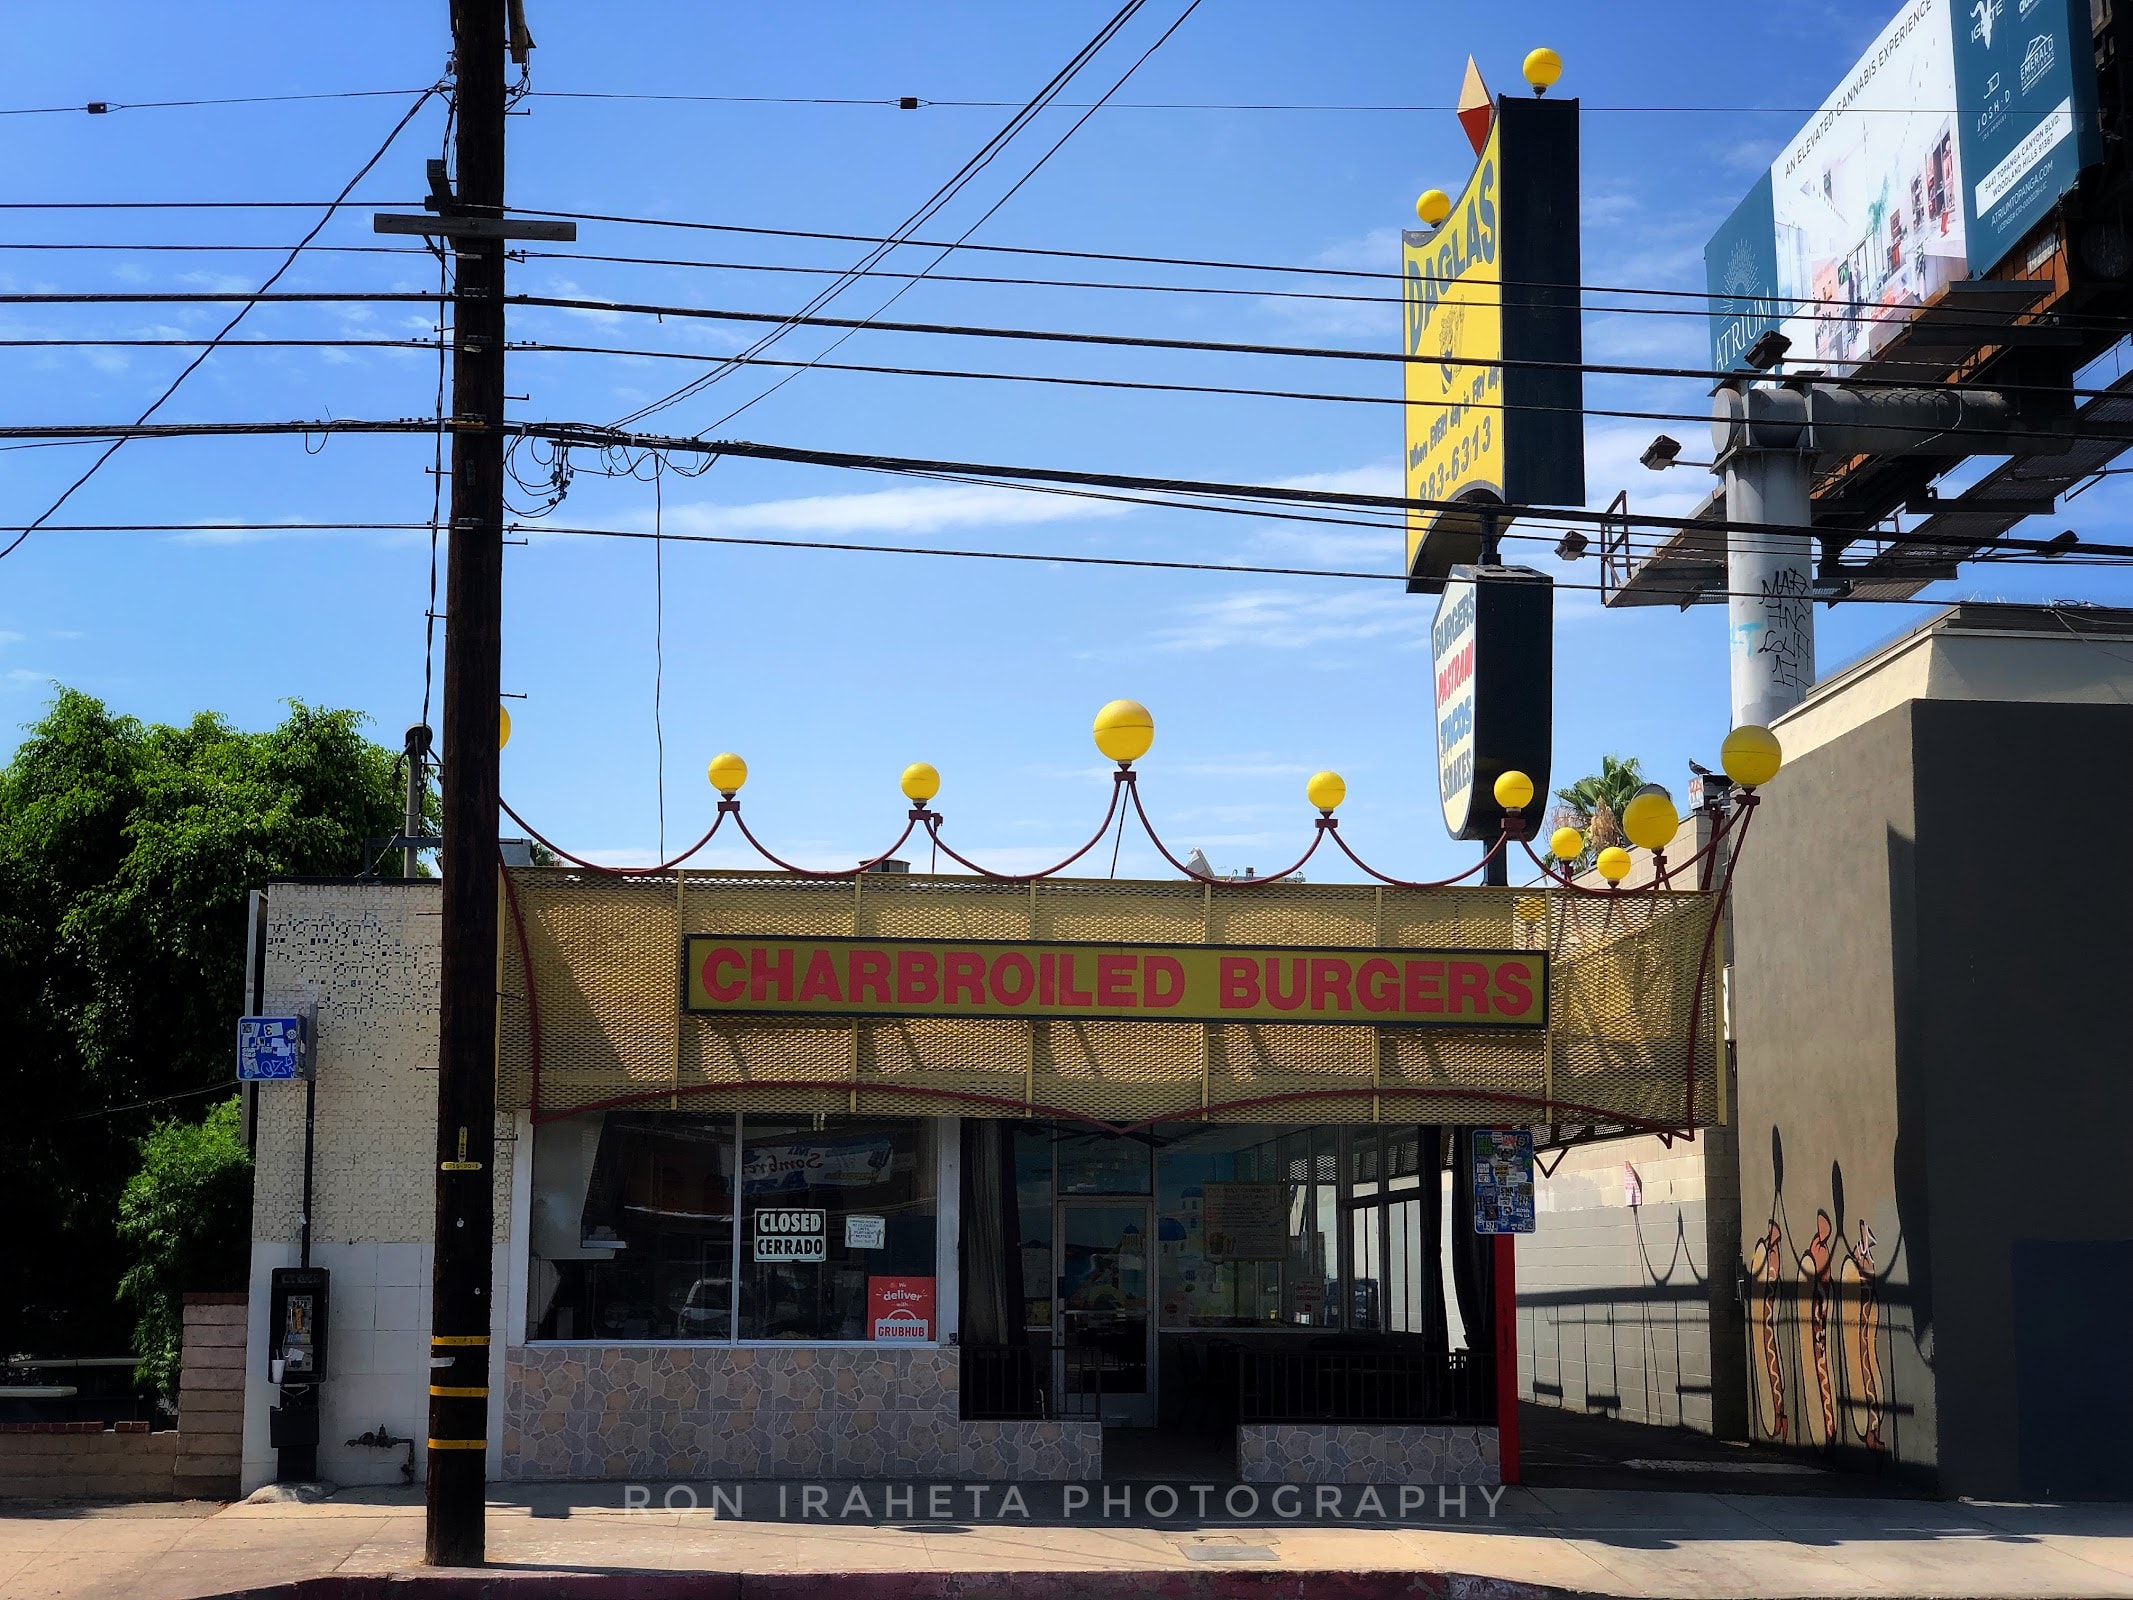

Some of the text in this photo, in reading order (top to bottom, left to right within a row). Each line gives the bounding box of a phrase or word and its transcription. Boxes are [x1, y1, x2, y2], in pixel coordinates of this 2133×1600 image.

[2020, 38, 2054, 80] EMERALD
[1785, 0, 1932, 179] AN ELEVATED CANNABIS EXPERIENCE
[1992, 163, 2021, 197] WOODLAND
[2022, 148, 2038, 171] HILLS
[1997, 153, 2021, 179] TOPANGA
[2021, 128, 2044, 156] CANYON
[1408, 159, 1496, 356] DAGLAS
[1715, 286, 1771, 372] ATRIUM
[1434, 586, 1475, 662] BURGERS
[1440, 695, 1472, 756] TACOS
[701, 946, 1533, 1017] CHARBROILED BURGERS
[757, 1238, 823, 1255] CERRADO
[759, 1213, 821, 1232] CLOSED
[883, 1290, 922, 1301] deliver
[878, 1326, 925, 1337] GRUBHUB
